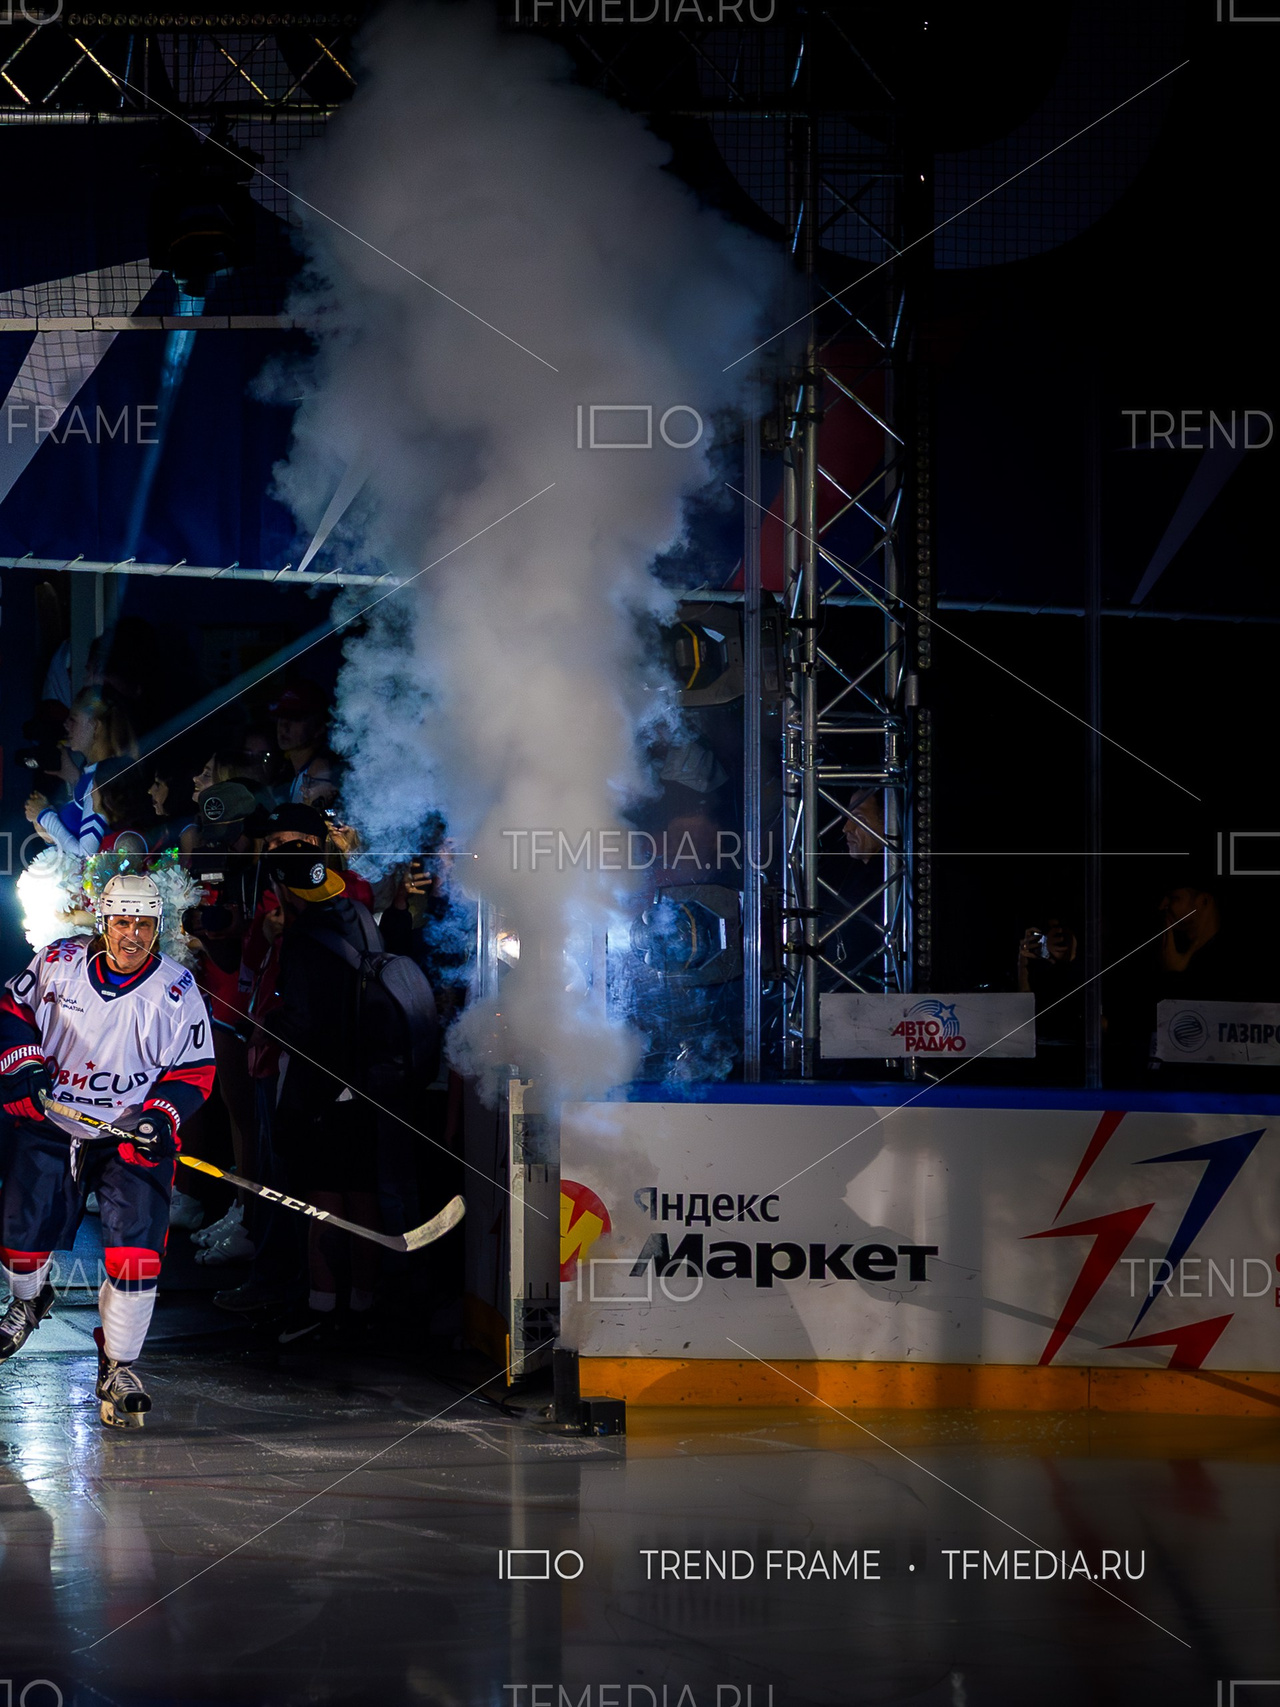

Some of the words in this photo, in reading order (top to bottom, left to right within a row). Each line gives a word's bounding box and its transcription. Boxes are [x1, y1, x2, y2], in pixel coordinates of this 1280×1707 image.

[891, 1020, 940, 1036] АВТО
[0, 1045, 43, 1073] WARRI
[905, 1036, 967, 1052] РАДИО
[258, 1186, 330, 1221] CCM
[633, 1186, 780, 1227] Яндекс
[628, 1232, 939, 1288] Маркет
